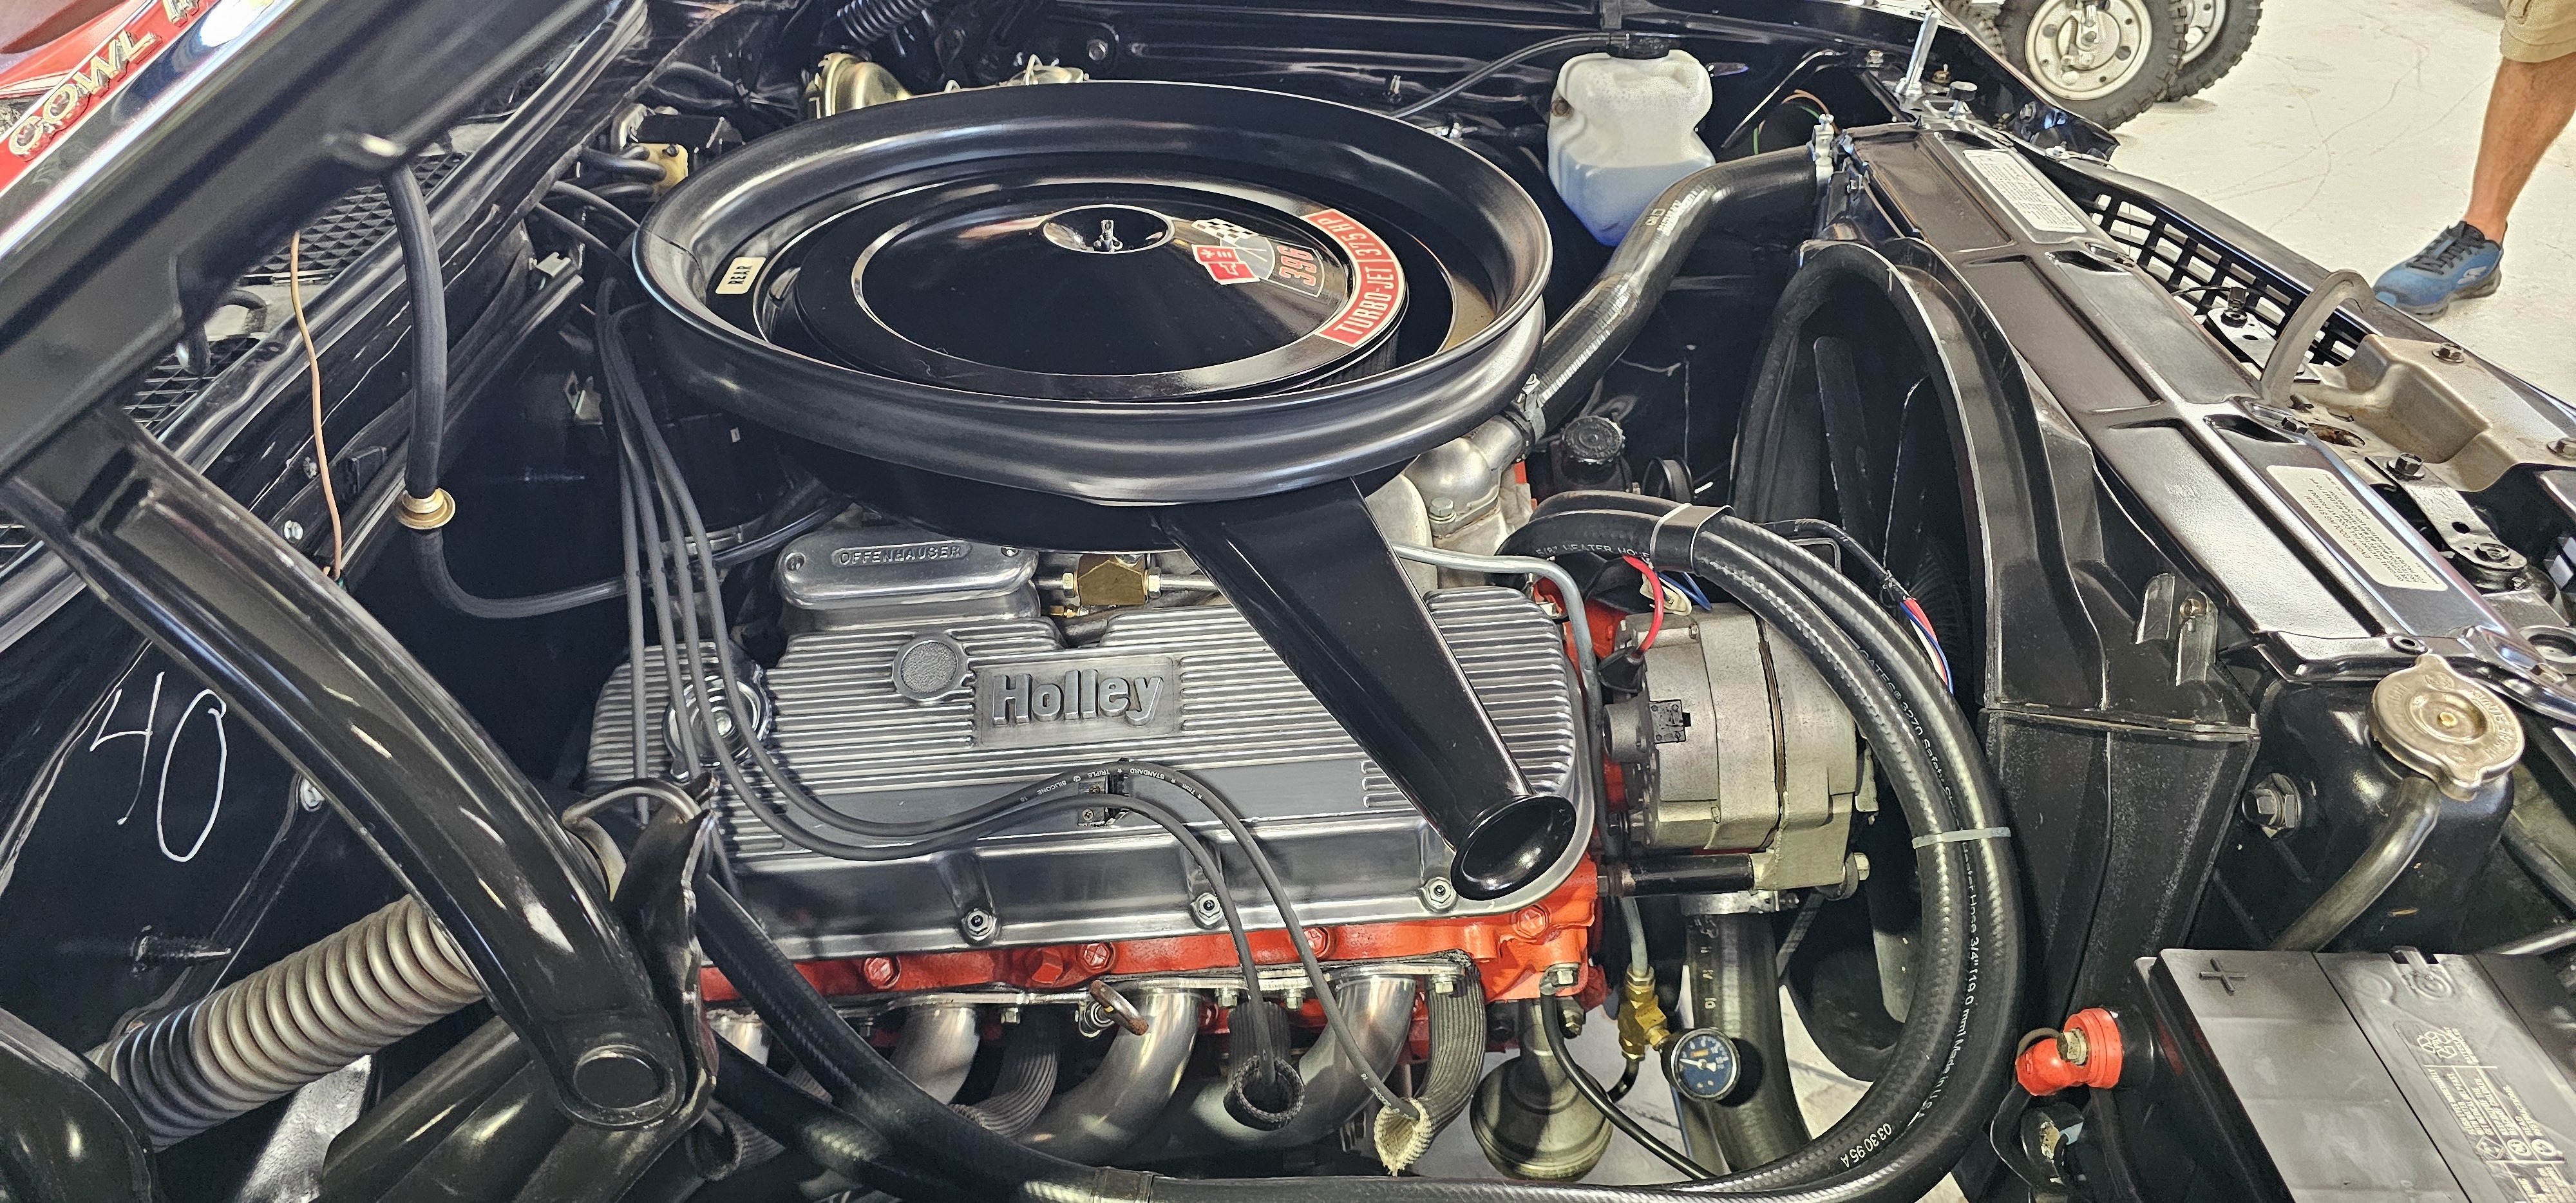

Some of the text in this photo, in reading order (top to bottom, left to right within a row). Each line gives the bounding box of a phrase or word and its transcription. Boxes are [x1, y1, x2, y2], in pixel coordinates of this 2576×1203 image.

[8, 30, 162, 156] COWL
[727, 265, 753, 285] REAR
[1276, 245, 1318, 287] 396
[1318, 217, 1395, 335] TURBO-JET 375 HP
[2322, 491, 2337, 504] LEAST
[2304, 496, 2371, 558] ENGINE COOLING SYSTEM
[2329, 510, 2350, 529] COOLANT
[2342, 511, 2368, 534] MAINTAINED
[2351, 513, 2366, 525] LIGHT
[1562, 544, 1615, 554] HEATER
[2358, 533, 2387, 559] PROTECTION
[2360, 540, 2381, 559] FACTORY
[2365, 527, 2396, 554] TEMPERATURE
[838, 545, 961, 565] OFFENHAUSER
[2394, 556, 2415, 573] PROPER
[2381, 562, 2403, 581] ORIGINAL
[2387, 560, 2410, 582] FREEZING
[2389, 556, 2418, 582] PROTECTION
[2413, 574, 2427, 583] FOR
[993, 669, 1164, 727] Holley
[90, 672, 227, 862] 40
[1923, 738, 1945, 782] Safet
[1087, 769, 1110, 779] TRIPLE
[1130, 768, 1165, 781] STANDARD
[1036, 780, 1068, 796] SILICONE
[1970, 936, 1979, 967] 3/4"
[1943, 1039, 1964, 1074] Made
[2429, 1069, 2476, 1134] FLUSH EYES IMMEDIATELY
[2456, 1086, 2470, 1099] HELP
[2470, 1087, 2484, 1097] THE
[2465, 1101, 2486, 1123] MEDICAL
[2485, 1107, 2499, 1119] OUT
[2470, 1121, 2485, 1134] WITH
[2481, 1125, 2494, 1135] GET
[2493, 1121, 2510, 1135] KEEP
[2498, 1115, 2518, 1135] REACH
[2514, 1116, 2533, 1135] READ
[1839, 1122, 1892, 1168] 03 30 95 A
